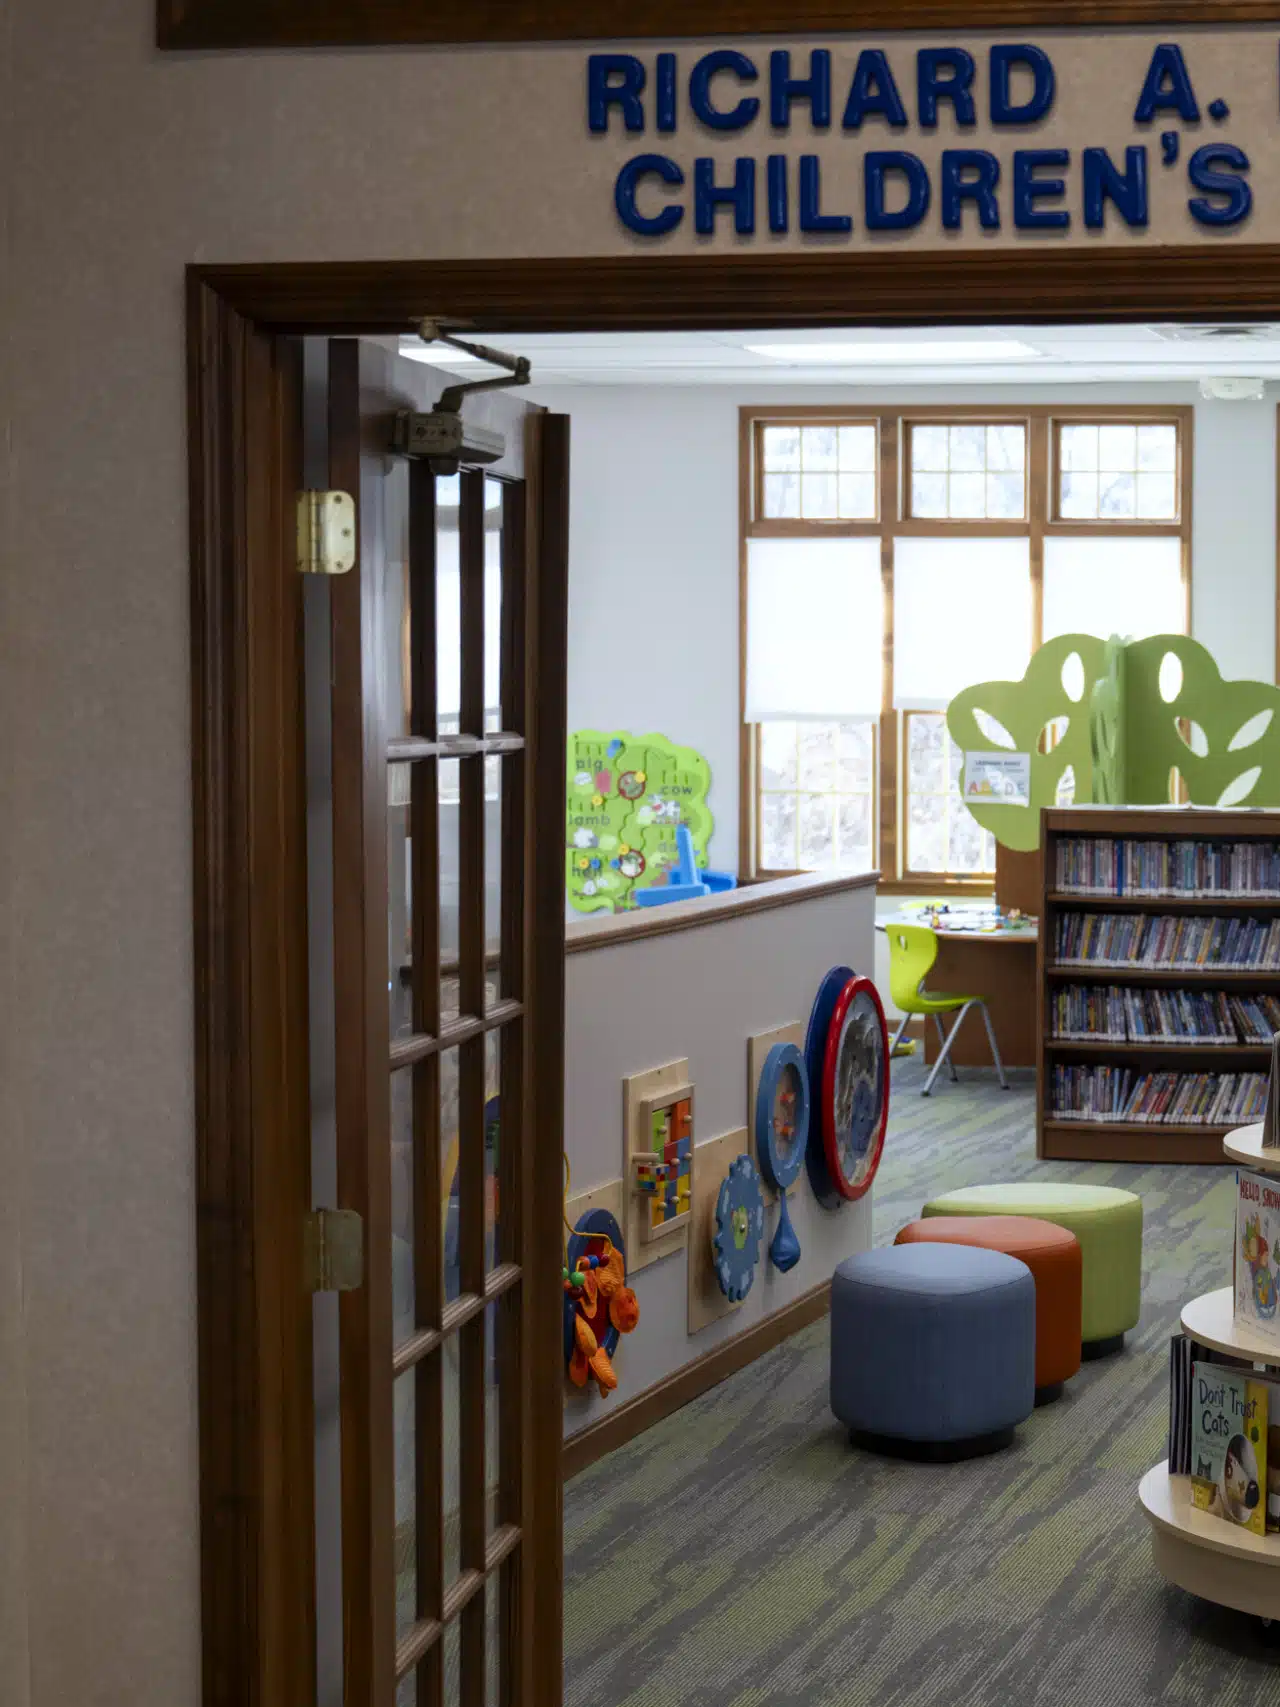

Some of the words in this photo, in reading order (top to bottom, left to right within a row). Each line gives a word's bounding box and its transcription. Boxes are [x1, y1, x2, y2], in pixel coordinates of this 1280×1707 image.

[588, 44, 1056, 133] RICHARD
[1133, 43, 1229, 123] A.
[615, 130, 1254, 236] CHILDREN'S
[576, 758, 604, 771] pig
[662, 785, 693, 796] cow
[568, 814, 611, 826] lamb
[1229, 1386, 1258, 1420] Trust
[1202, 1409, 1230, 1437] Cats
